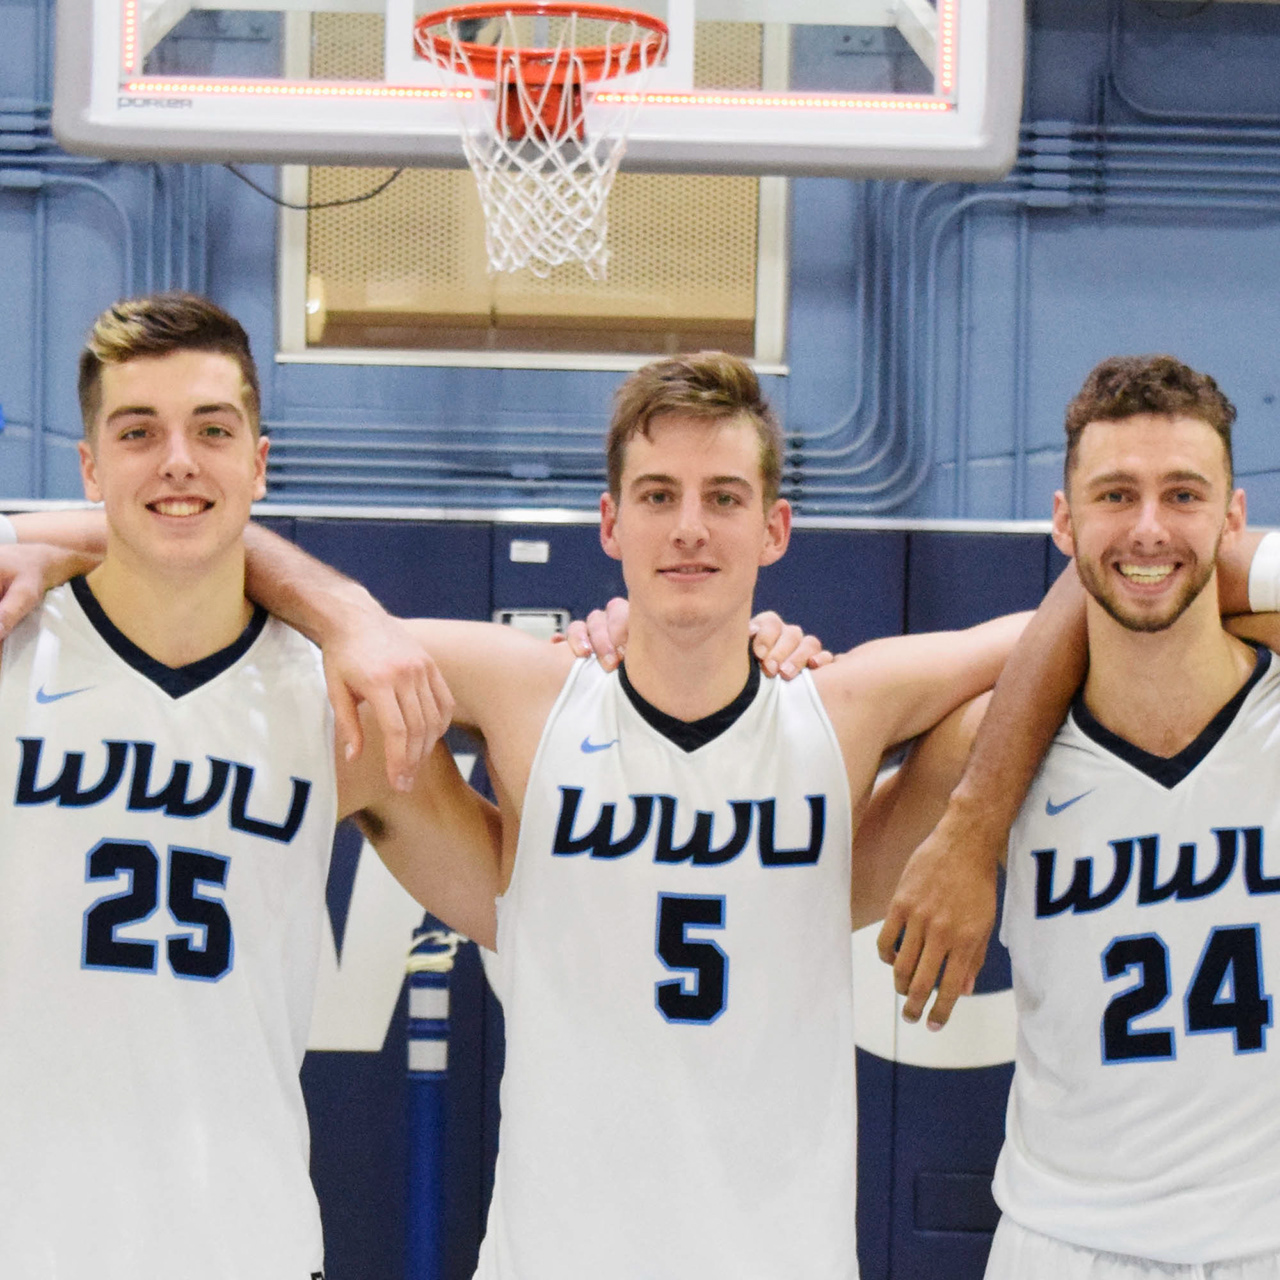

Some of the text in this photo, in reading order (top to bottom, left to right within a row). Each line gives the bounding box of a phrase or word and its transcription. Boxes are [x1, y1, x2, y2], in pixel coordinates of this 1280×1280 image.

[13, 736, 312, 845] WWU
[551, 784, 826, 869] WWU
[80, 837, 235, 983] 25
[654, 891, 730, 1026] 5
[1100, 922, 1274, 1066] 24
